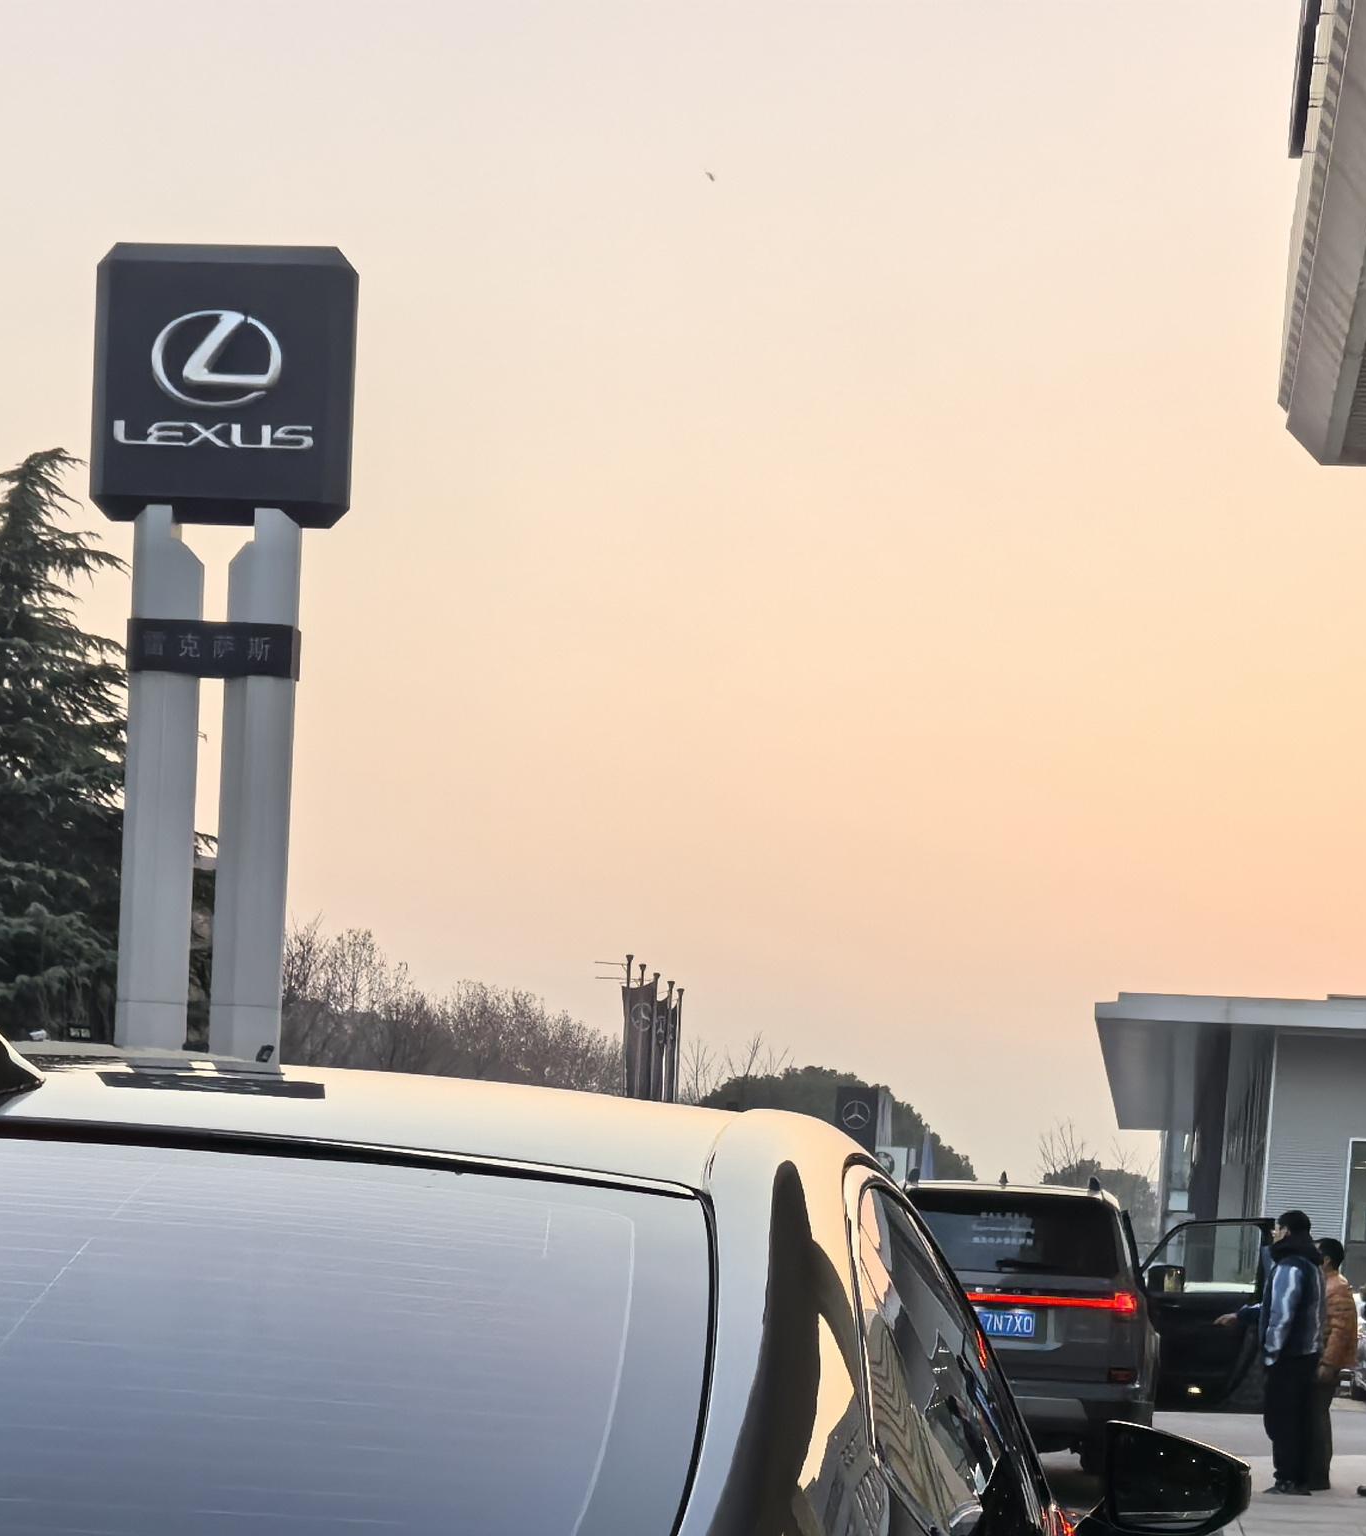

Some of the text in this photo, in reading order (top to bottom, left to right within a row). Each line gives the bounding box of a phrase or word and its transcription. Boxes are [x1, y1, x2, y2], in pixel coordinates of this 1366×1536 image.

[113, 419, 314, 449] LEXUS
[143, 630, 272, 662] 雷克萨斯
